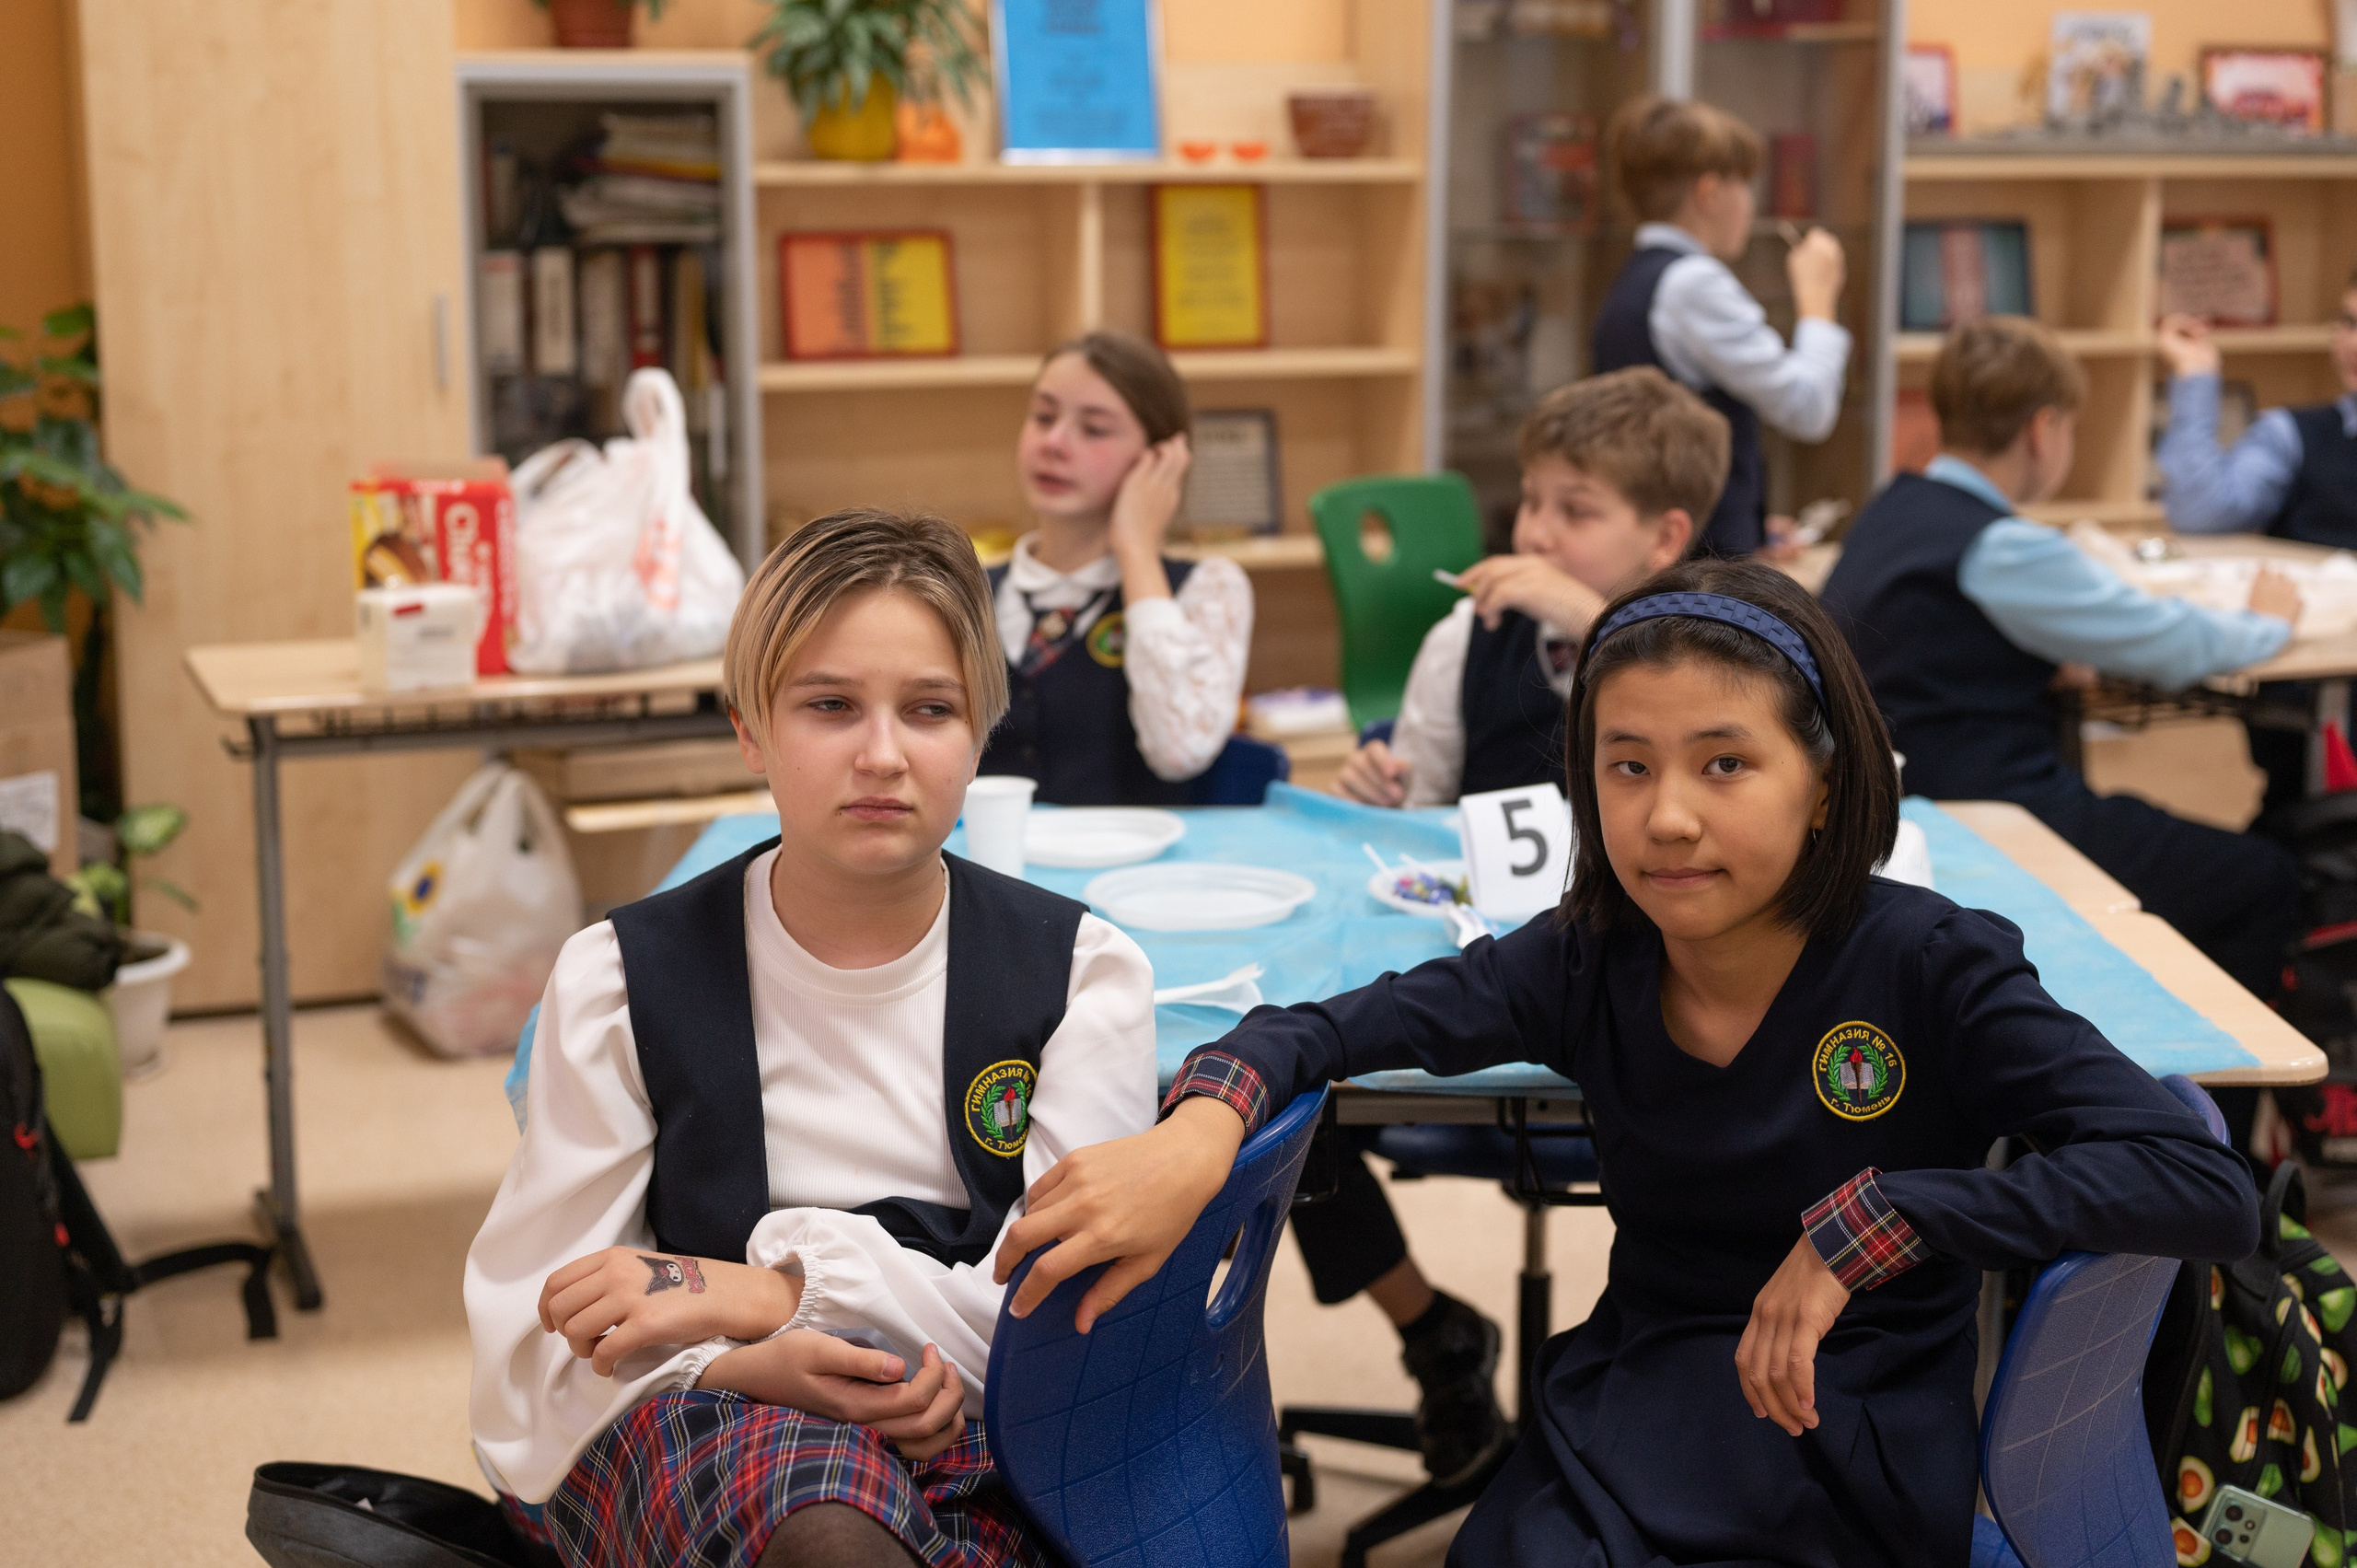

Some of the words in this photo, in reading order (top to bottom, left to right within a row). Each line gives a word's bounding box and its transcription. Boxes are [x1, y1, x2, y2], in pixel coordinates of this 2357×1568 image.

[1501, 798, 1548, 877] 5
[1818, 1028, 1870, 1072] ГИМНАЗИЯ
[1885, 1052, 1898, 1067] 16
[971, 1067, 1023, 1112] ГИМНАЗИЯ
[1843, 1096, 1891, 1114] Тюмень
